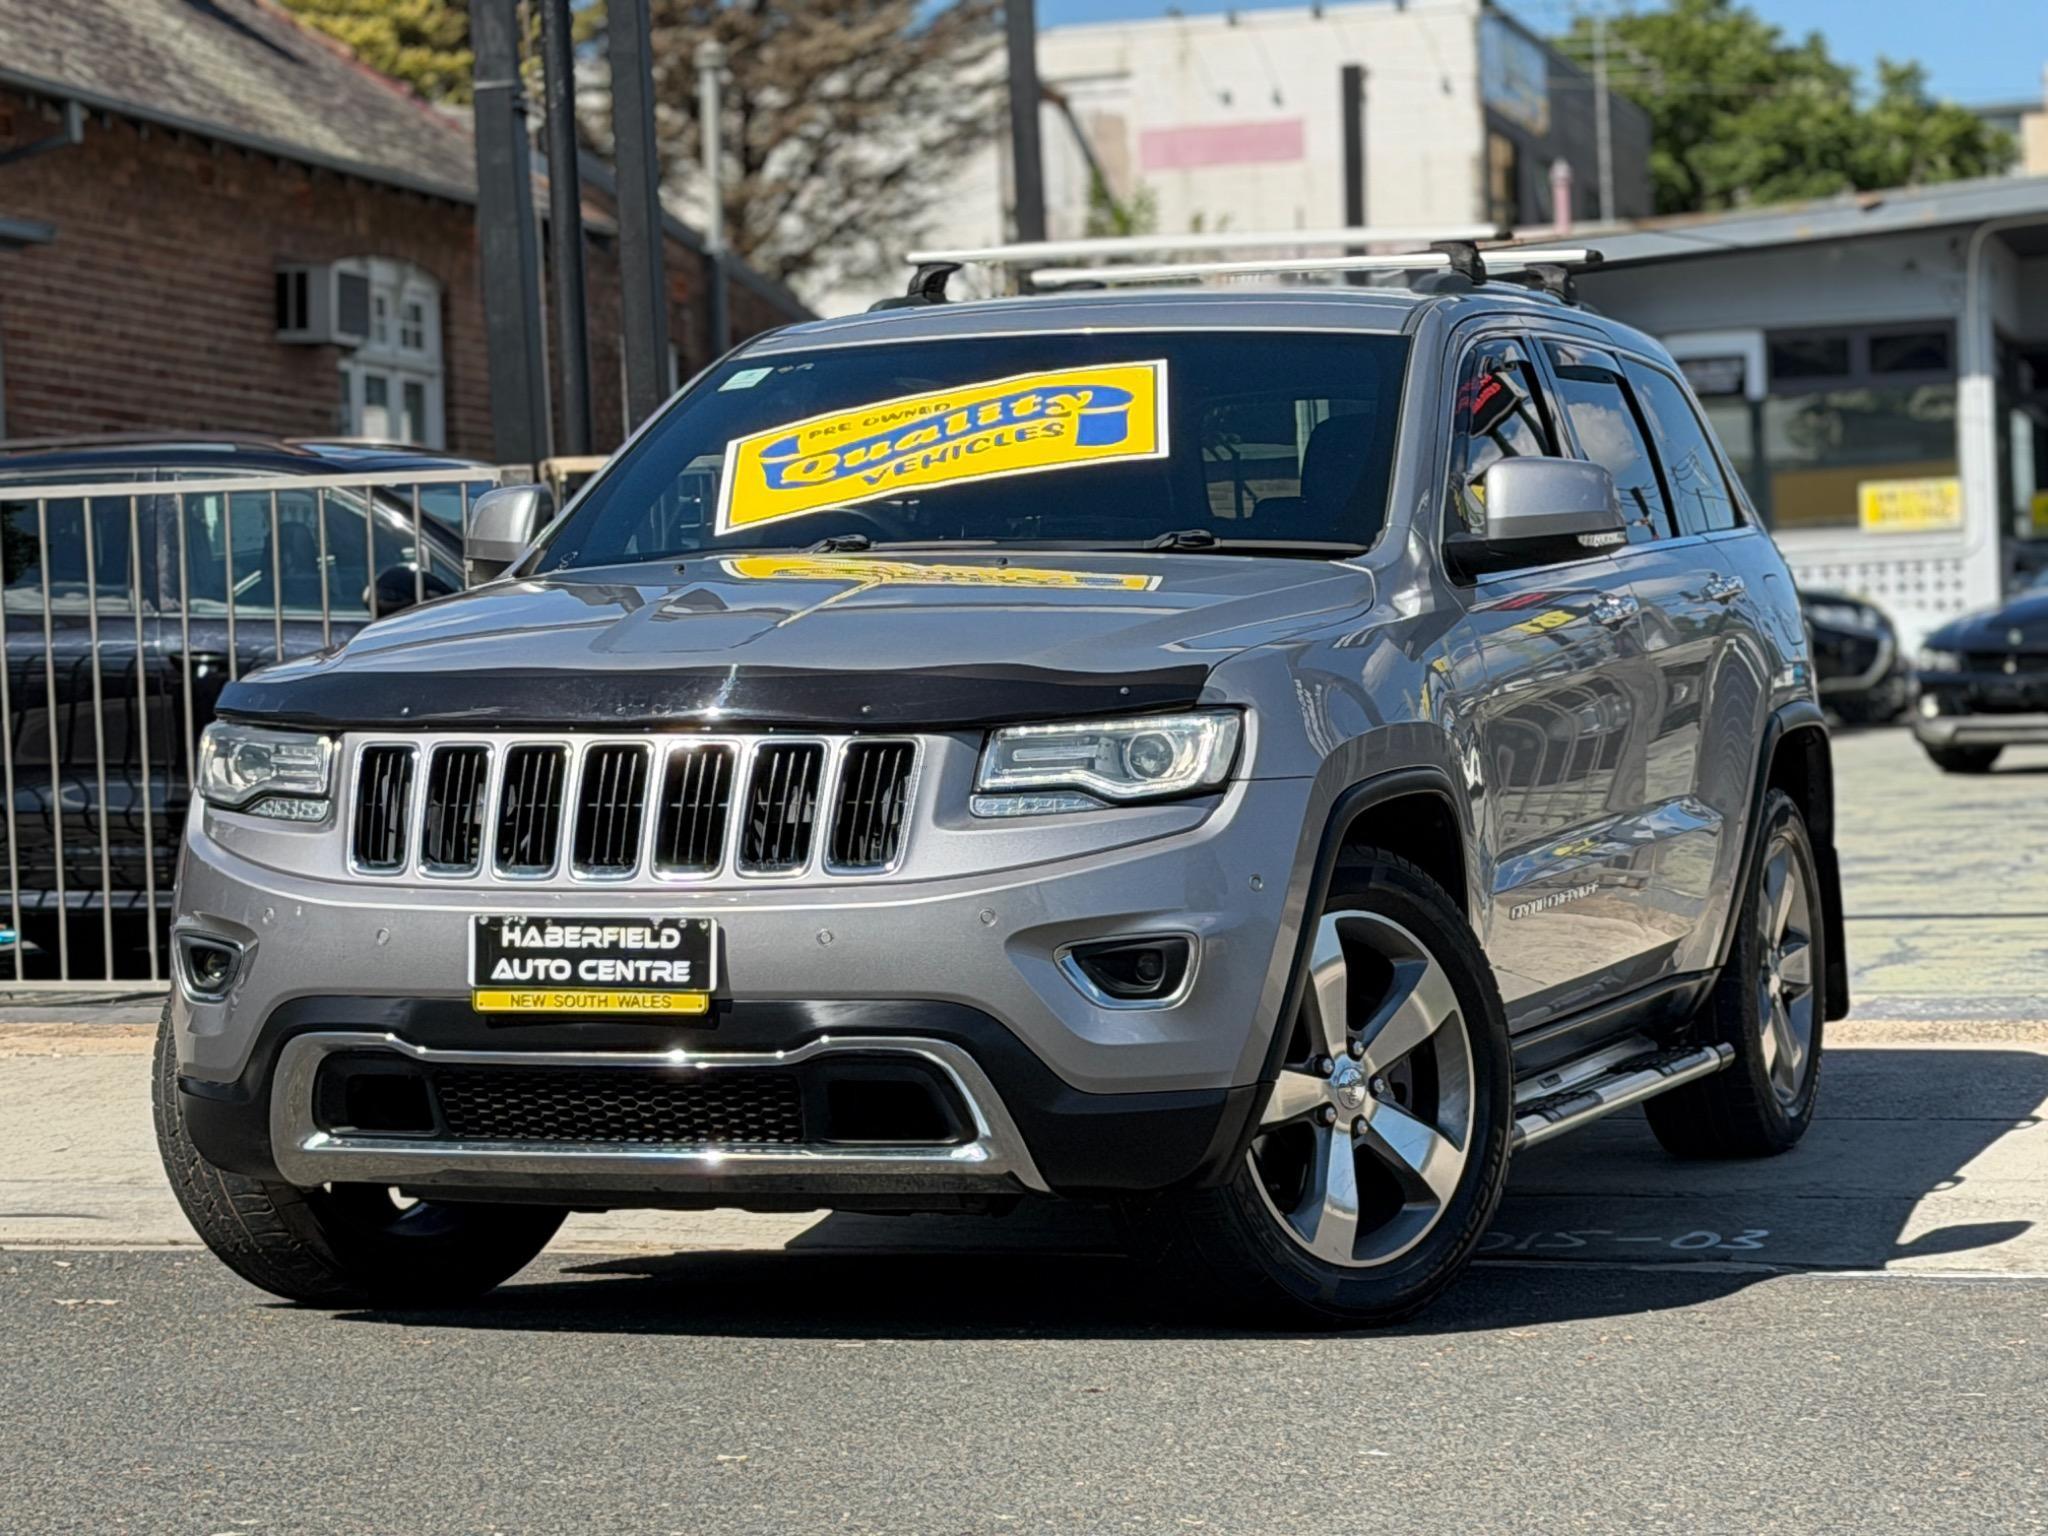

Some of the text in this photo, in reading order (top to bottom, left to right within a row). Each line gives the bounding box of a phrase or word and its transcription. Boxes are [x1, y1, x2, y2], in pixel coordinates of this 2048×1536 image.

[809, 404, 951, 439] PRE OWNED
[780, 390, 1093, 485] Quality
[862, 422, 1065, 485] VEHICLES
[501, 925, 681, 949] HABERFIELD
[490, 958, 691, 982] AUTO CENTRE
[510, 993, 672, 1009] NEW SOUTH WALES
